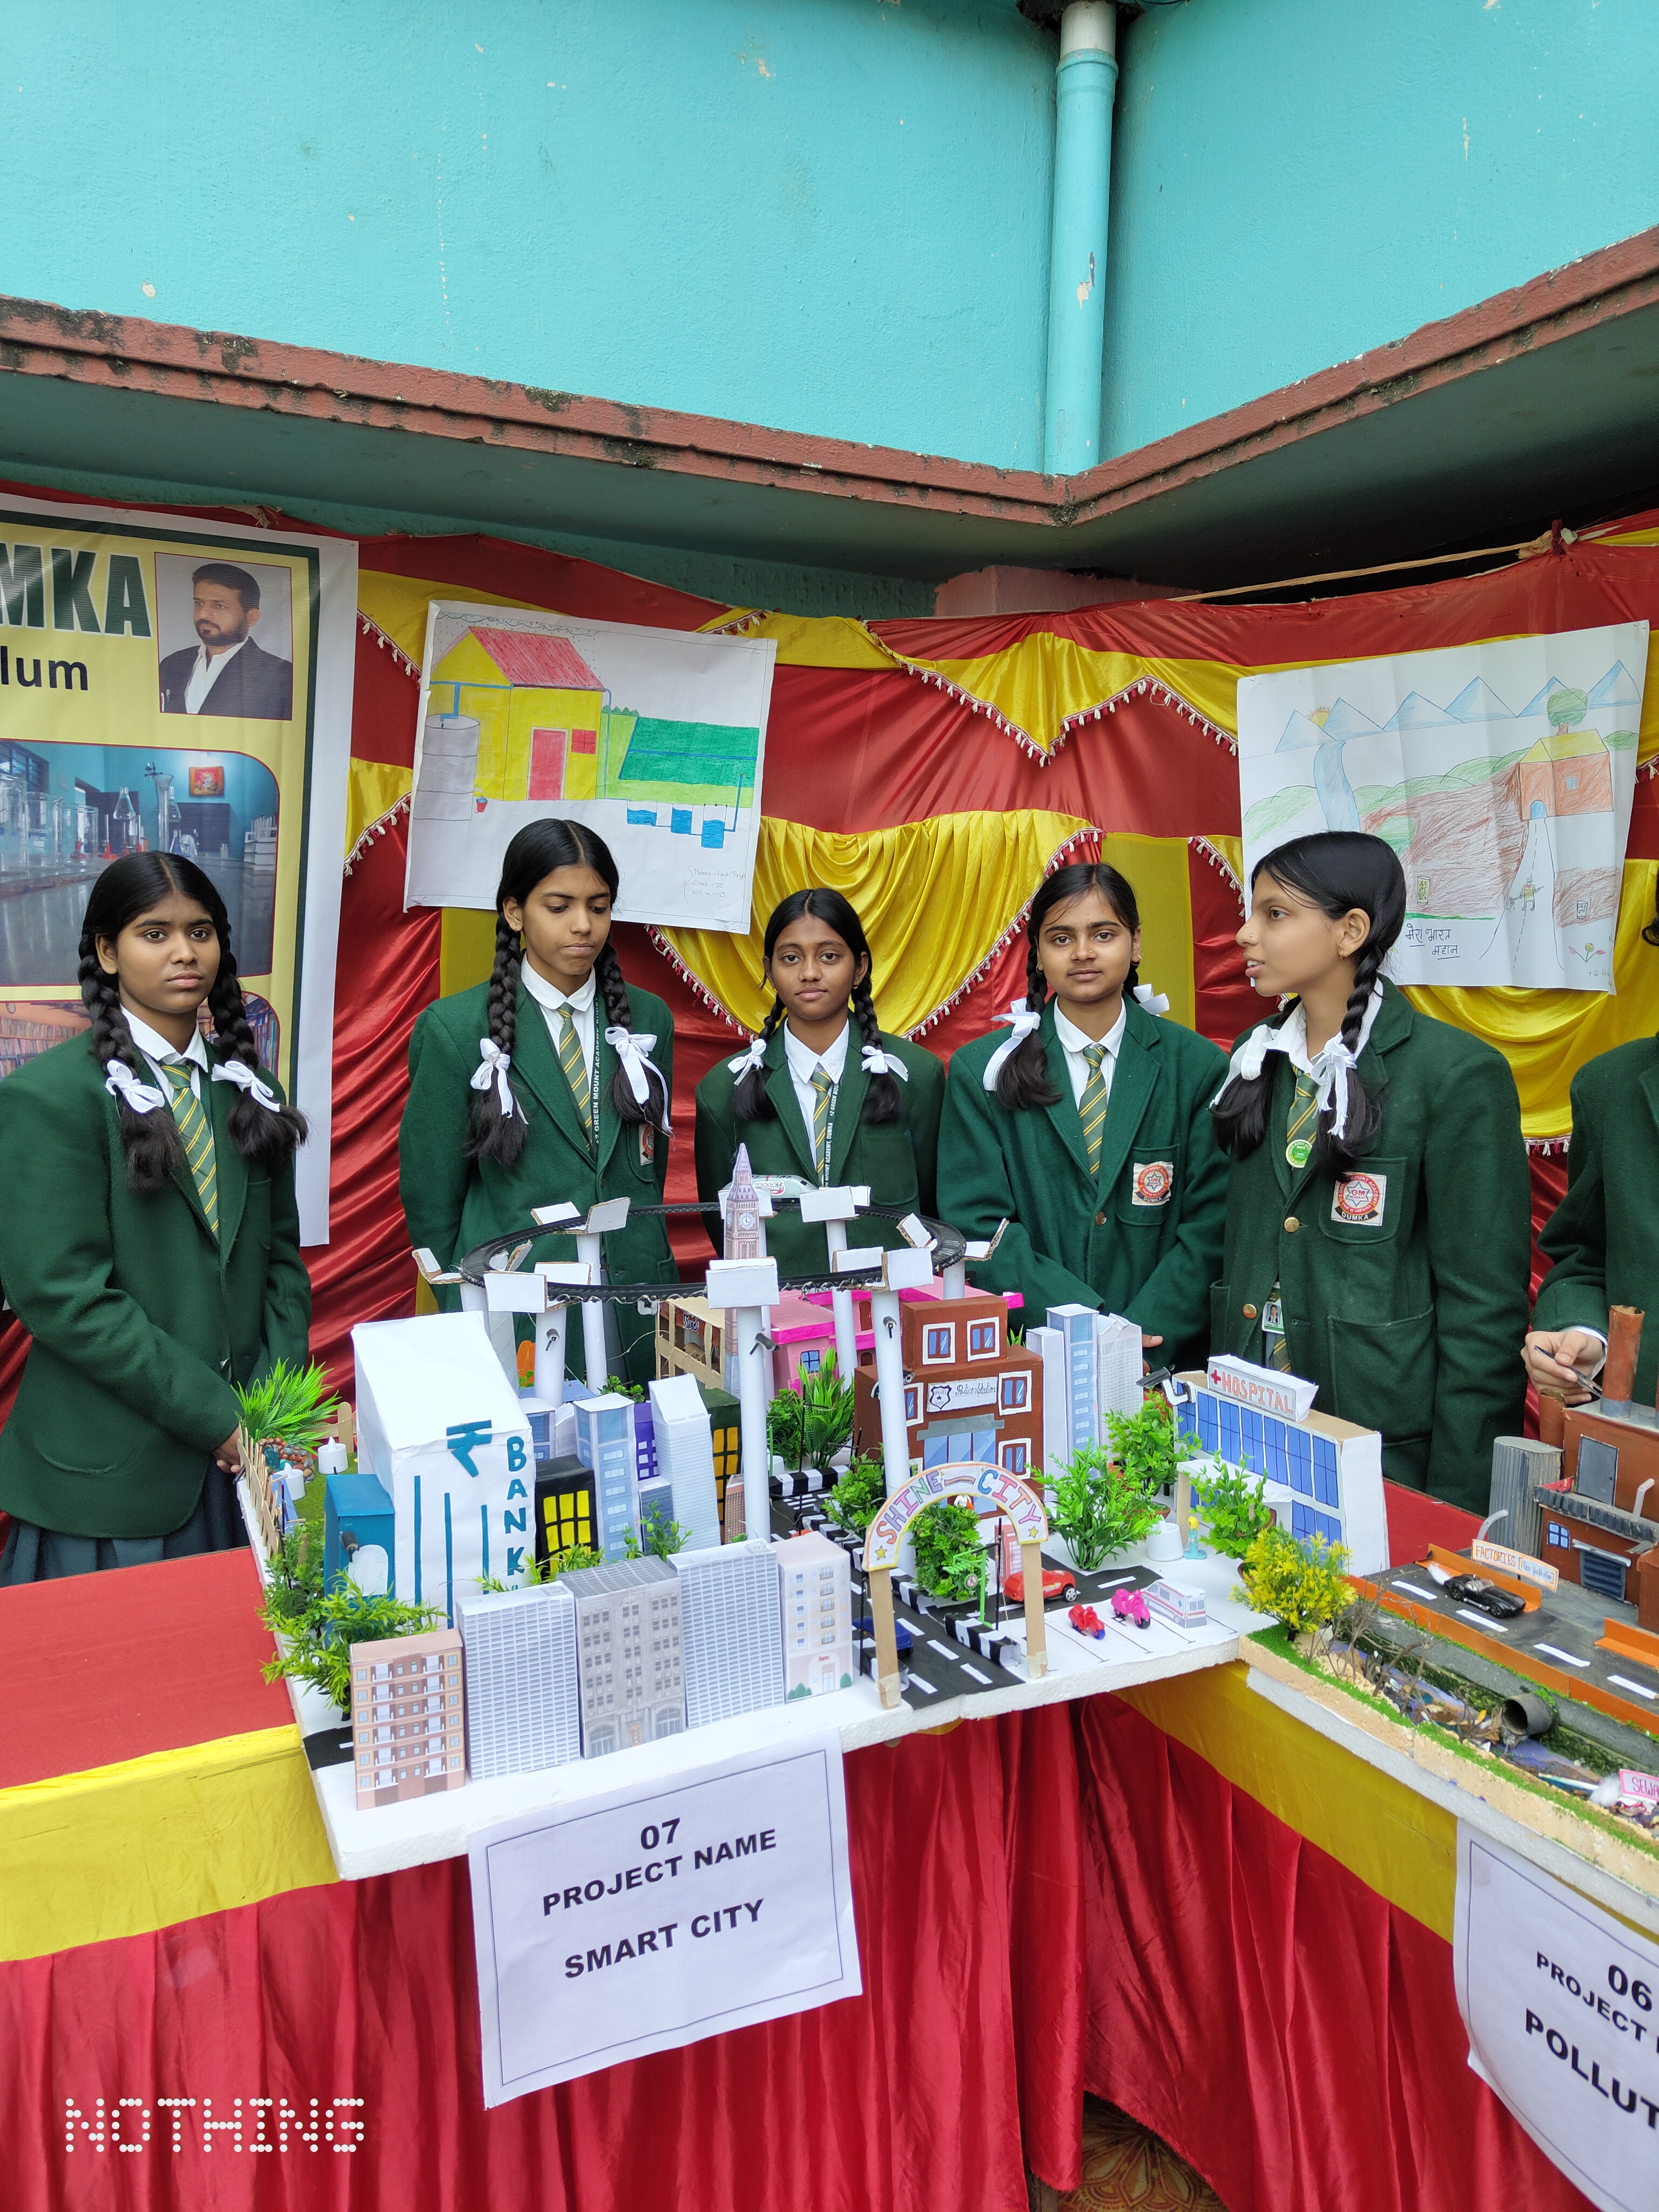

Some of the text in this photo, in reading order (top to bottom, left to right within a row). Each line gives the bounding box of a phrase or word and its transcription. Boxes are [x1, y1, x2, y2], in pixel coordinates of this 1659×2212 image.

[0, 645, 89, 691] lum
[694, 868, 712, 876] Name
[1405, 923, 1451, 943] मेरा भारत
[1432, 945, 1459, 955] महान
[1368, 1181, 1378, 1204] ACADEMY
[1341, 1211, 1369, 1220] DUMKA
[955, 1384, 974, 1396] Police
[975, 1382, 996, 1398] Station
[1222, 1371, 1293, 1415] HOSPITAL
[504, 1435, 528, 1576] BANK
[876, 1470, 944, 1545] SHINE
[978, 1469, 1042, 1525] CITY
[1476, 1545, 1516, 1567] FACTORIES
[640, 1817, 681, 1851] 07
[543, 1828, 777, 1917] PROJECT NAME
[564, 1898, 765, 1979] SMART CITY
[1536, 1950, 1647, 2042] PROJECT
[1608, 1965, 1653, 2012] 06
[1526, 2007, 1659, 2130] POLLUT
